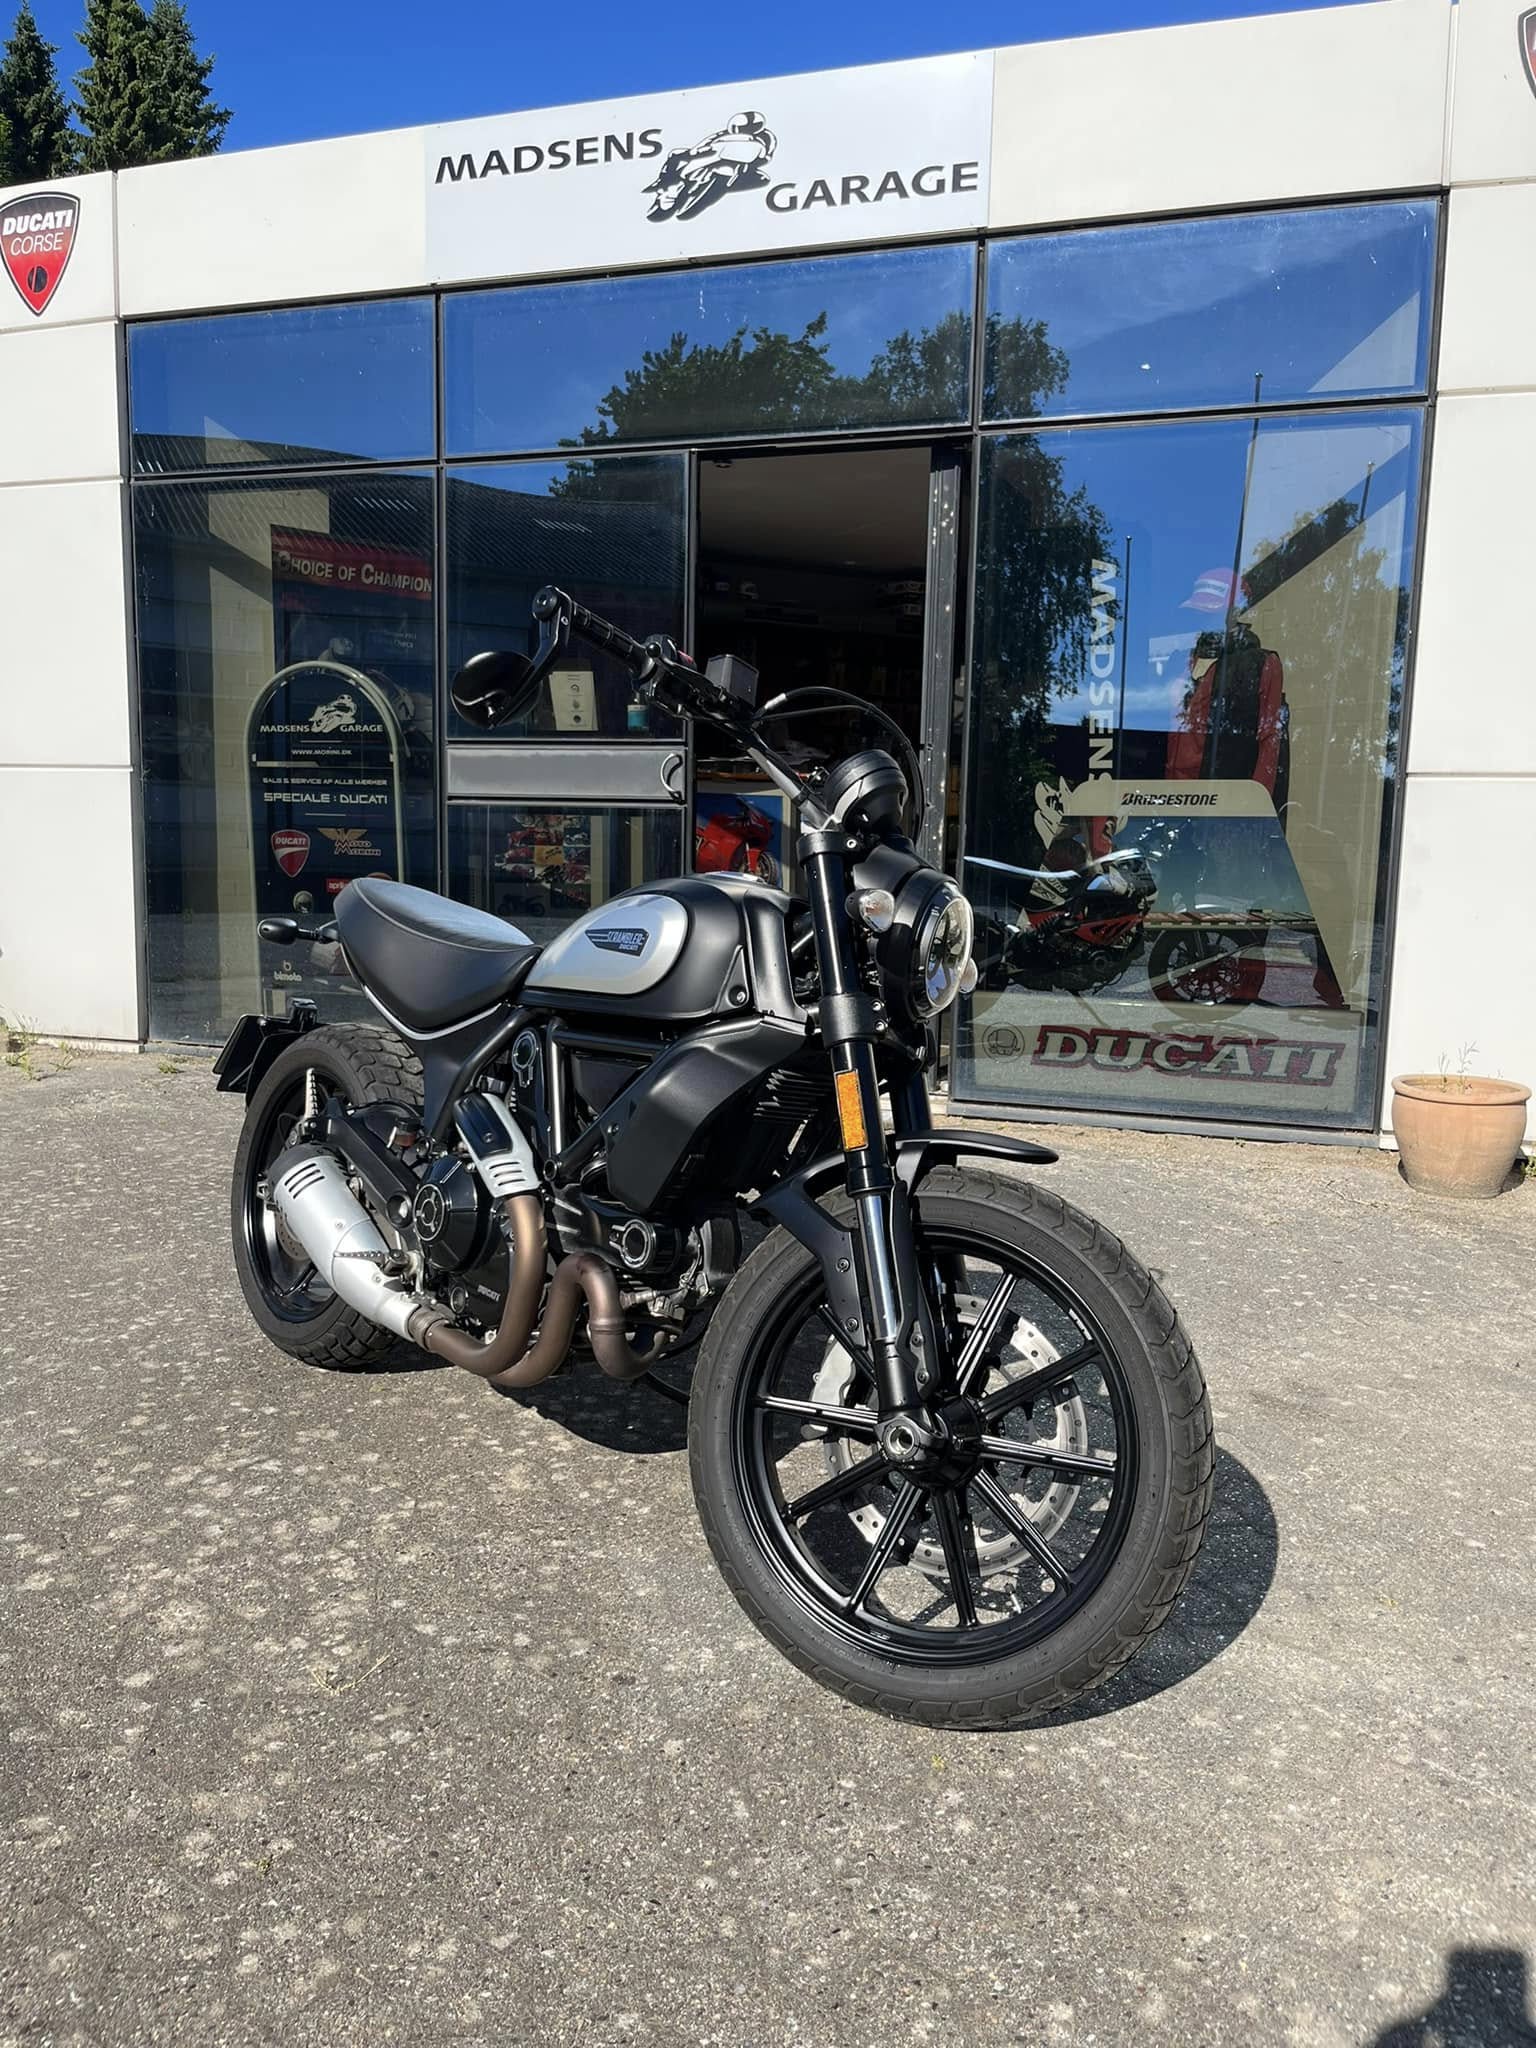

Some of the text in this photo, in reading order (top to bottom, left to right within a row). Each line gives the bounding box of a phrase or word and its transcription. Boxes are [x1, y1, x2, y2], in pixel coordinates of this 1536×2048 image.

[435, 127, 664, 184] MADSENS
[765, 160, 980, 213] GARAGE
[2, 208, 74, 236] DUCATI
[10, 231, 65, 256] CORSE
[259, 724, 384, 733] MADSENS GARAGE
[263, 791, 331, 803] SPECIALE
[339, 794, 388, 805] DUCATI
[1120, 792, 1219, 807] BRIDGESTONE
[274, 836, 307, 846] DUCATI
[1036, 1027, 1342, 1084] DUCATI
